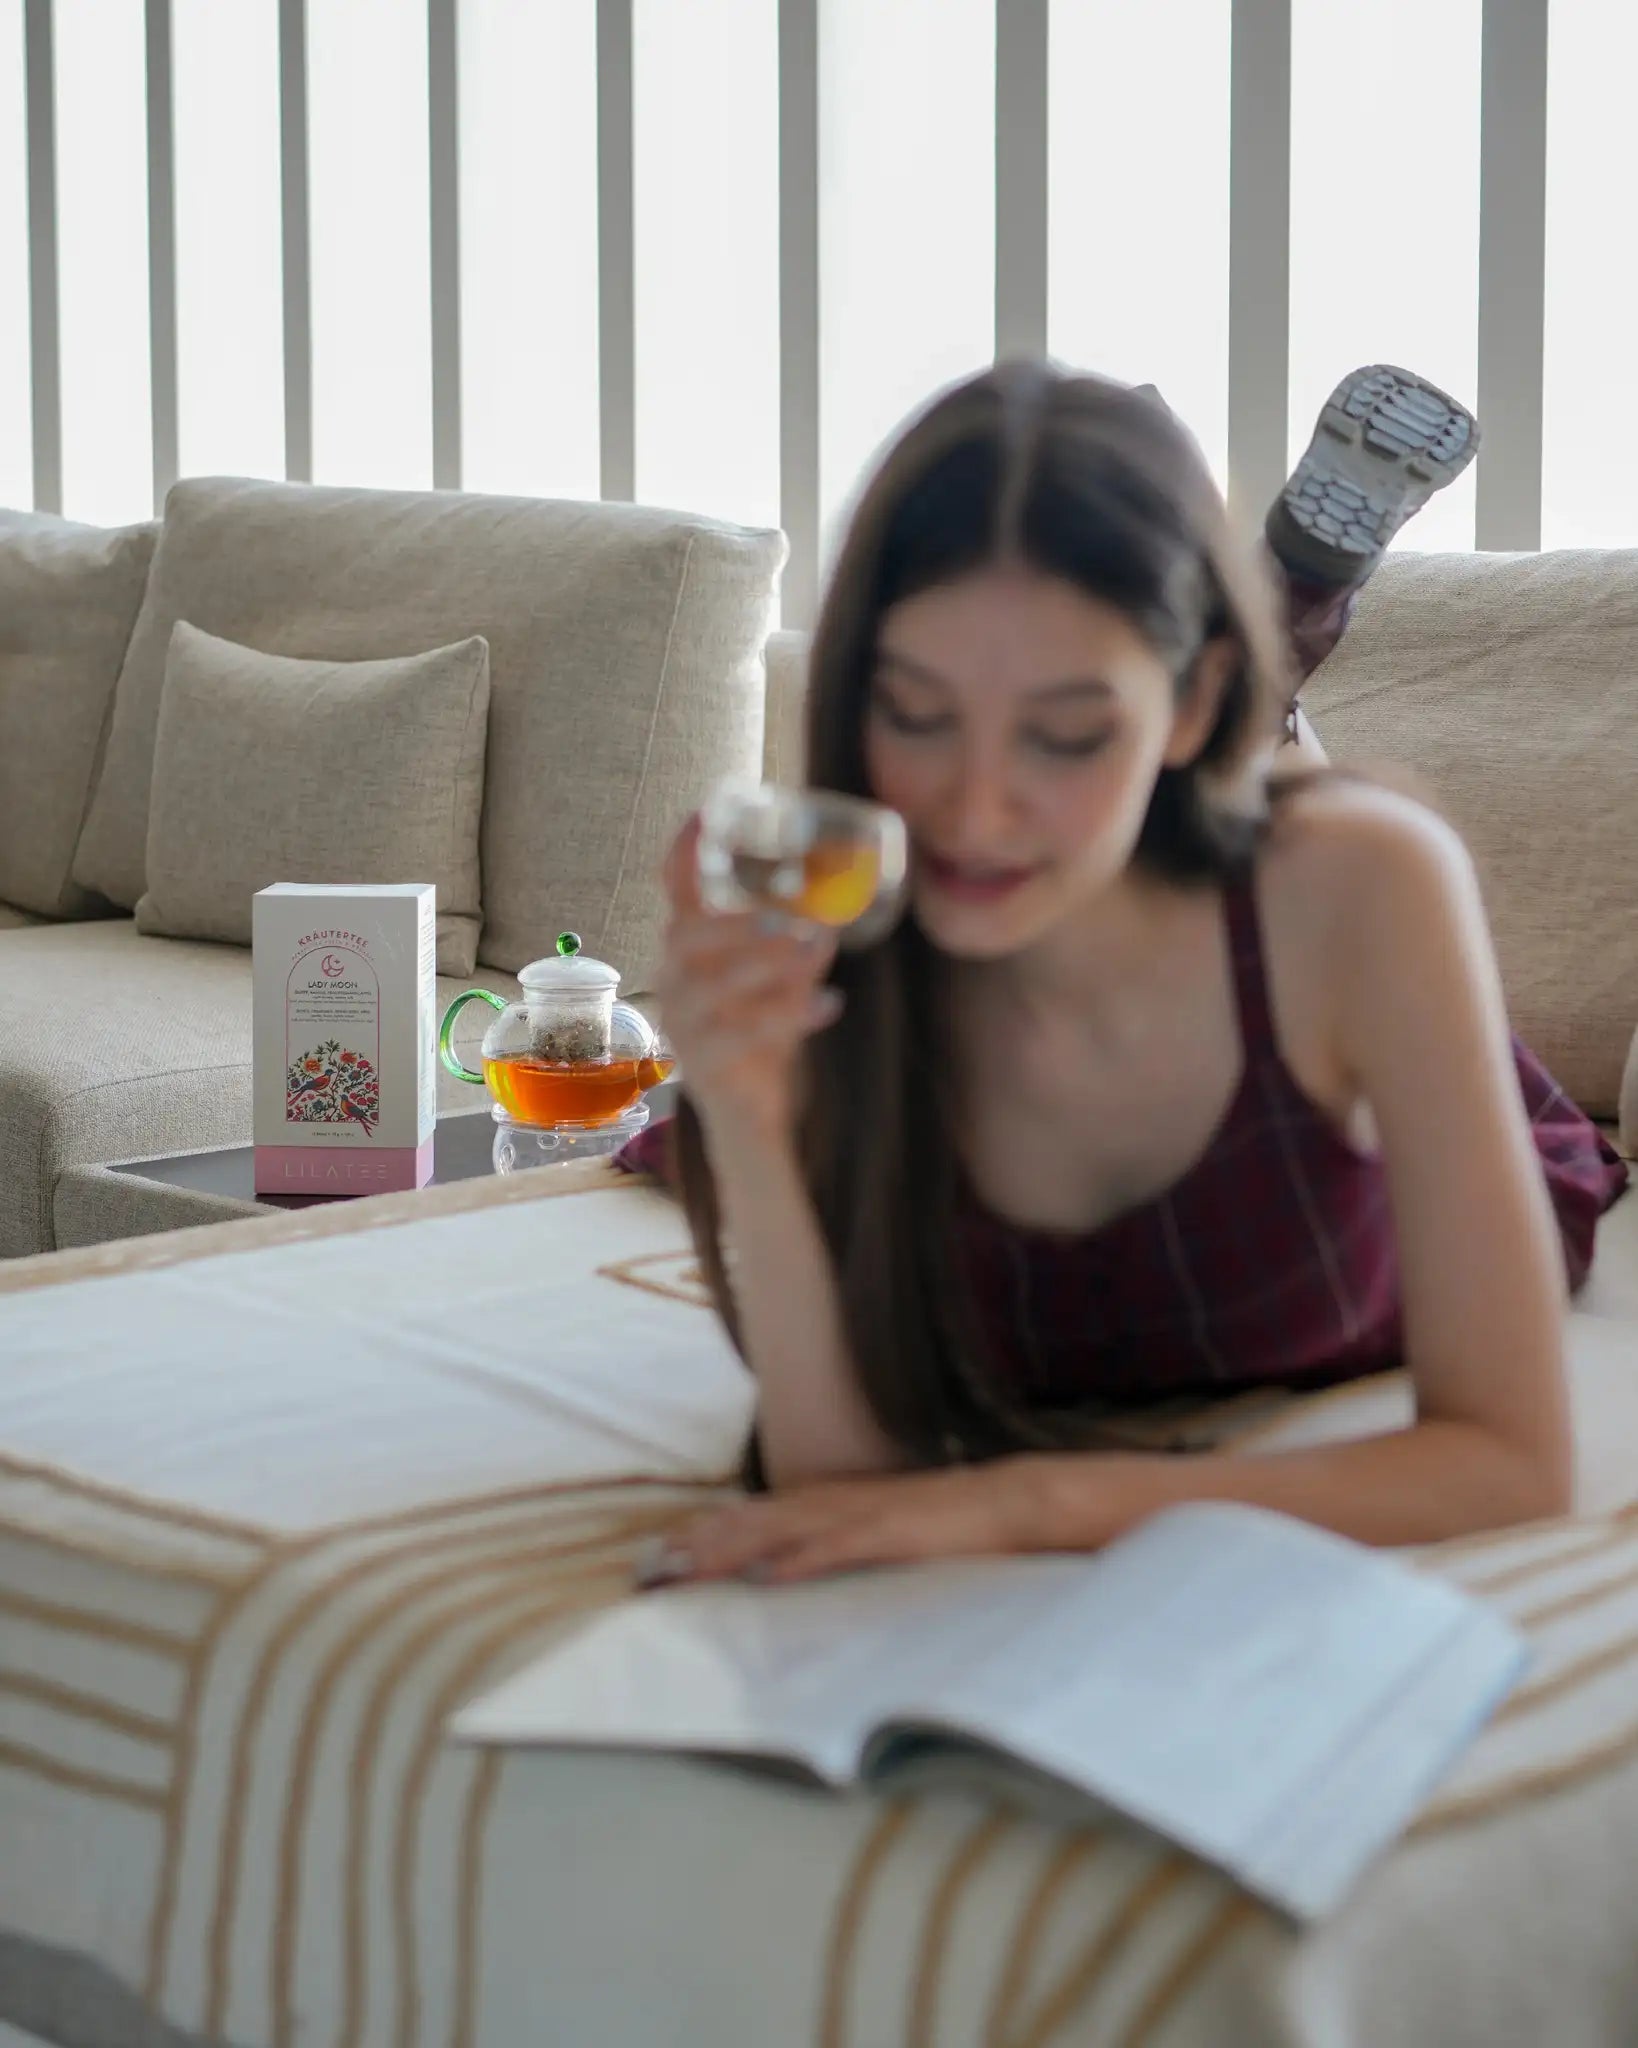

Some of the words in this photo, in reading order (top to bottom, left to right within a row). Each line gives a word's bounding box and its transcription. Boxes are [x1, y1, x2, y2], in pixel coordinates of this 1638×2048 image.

[297, 930, 369, 948] KRÄUTERTEE
[308, 981, 328, 989] LADY
[330, 981, 358, 989] MOON
[285, 1162, 388, 1180] LILATEE
